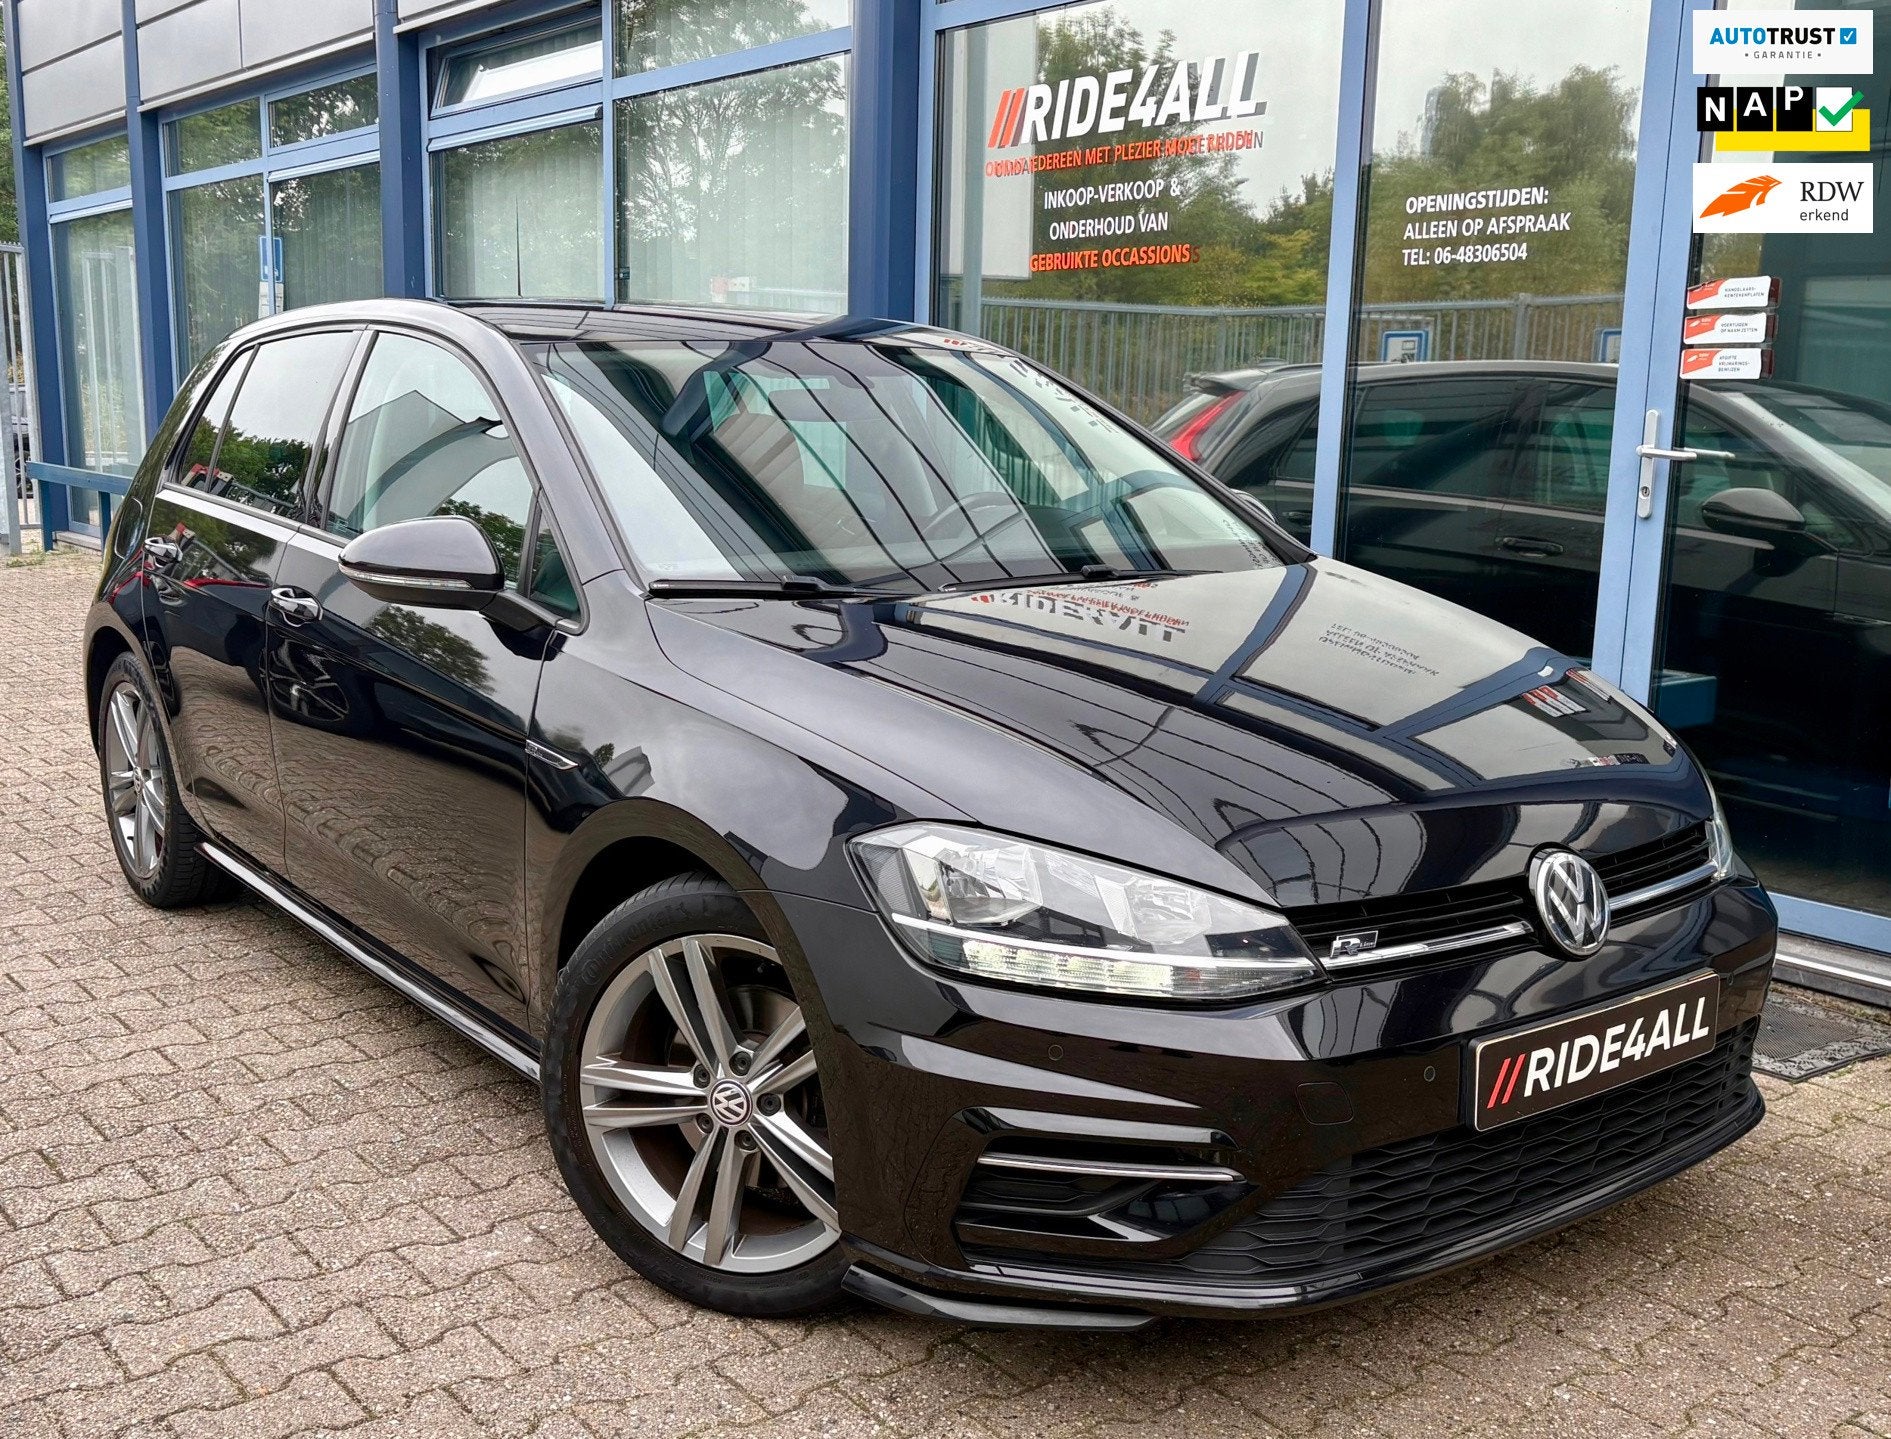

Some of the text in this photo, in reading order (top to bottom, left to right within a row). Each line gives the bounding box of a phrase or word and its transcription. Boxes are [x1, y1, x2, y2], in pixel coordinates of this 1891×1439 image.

[1029, 151, 1083, 174] IEDEREEN
[1085, 146, 1111, 165] MET
[1114, 139, 1161, 160] PLEZIER
[1044, 178, 1182, 210] INKOOP-VERKOOP &
[1405, 186, 1549, 214] OPENINGSTIJDEN:
[1049, 212, 1168, 241] ONDERHOUD VAN
[1403, 212, 1571, 240] ALLEEN OP AFSPRAAK
[1029, 244, 1192, 272] GEBRUIKTE OCCASSIONS
[1402, 243, 1527, 265] TEL: 06-48306504
